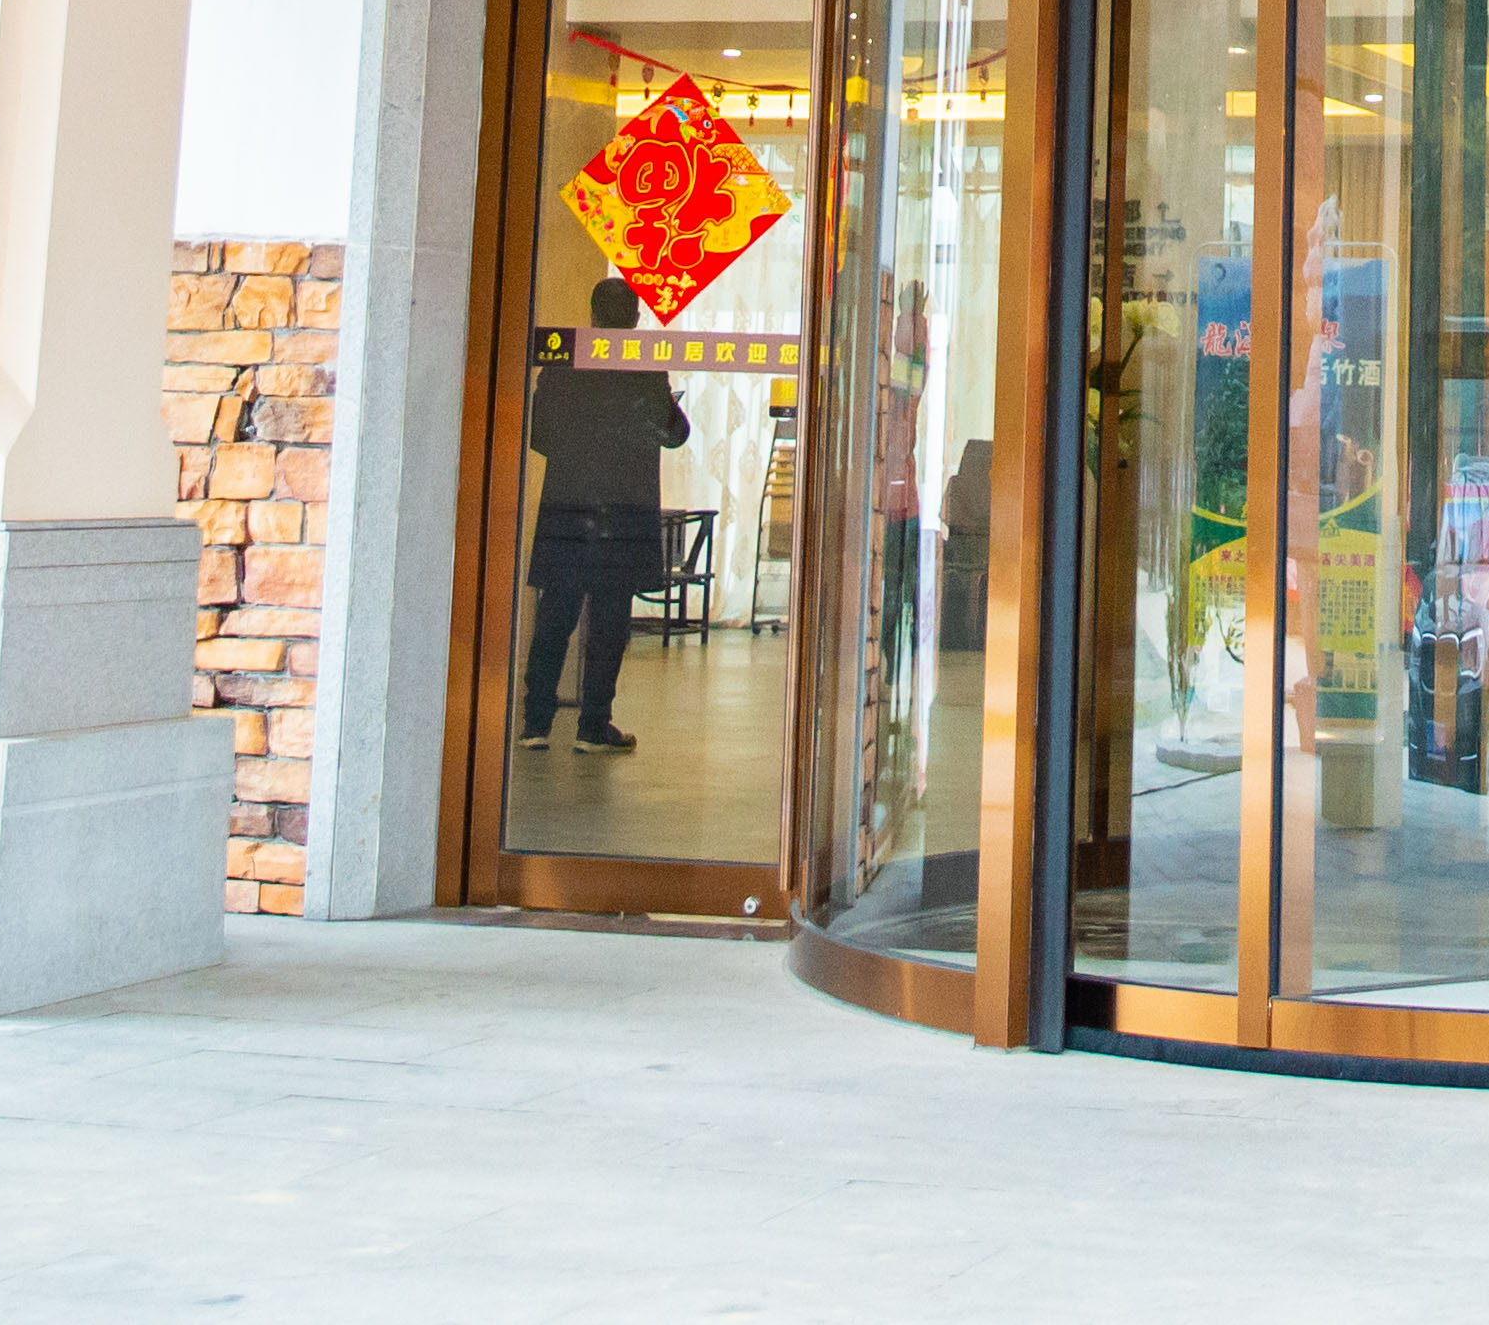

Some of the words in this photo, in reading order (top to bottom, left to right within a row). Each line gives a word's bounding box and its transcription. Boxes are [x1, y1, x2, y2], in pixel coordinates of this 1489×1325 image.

[591, 338, 799, 365] 龙溪山居欢迎您
